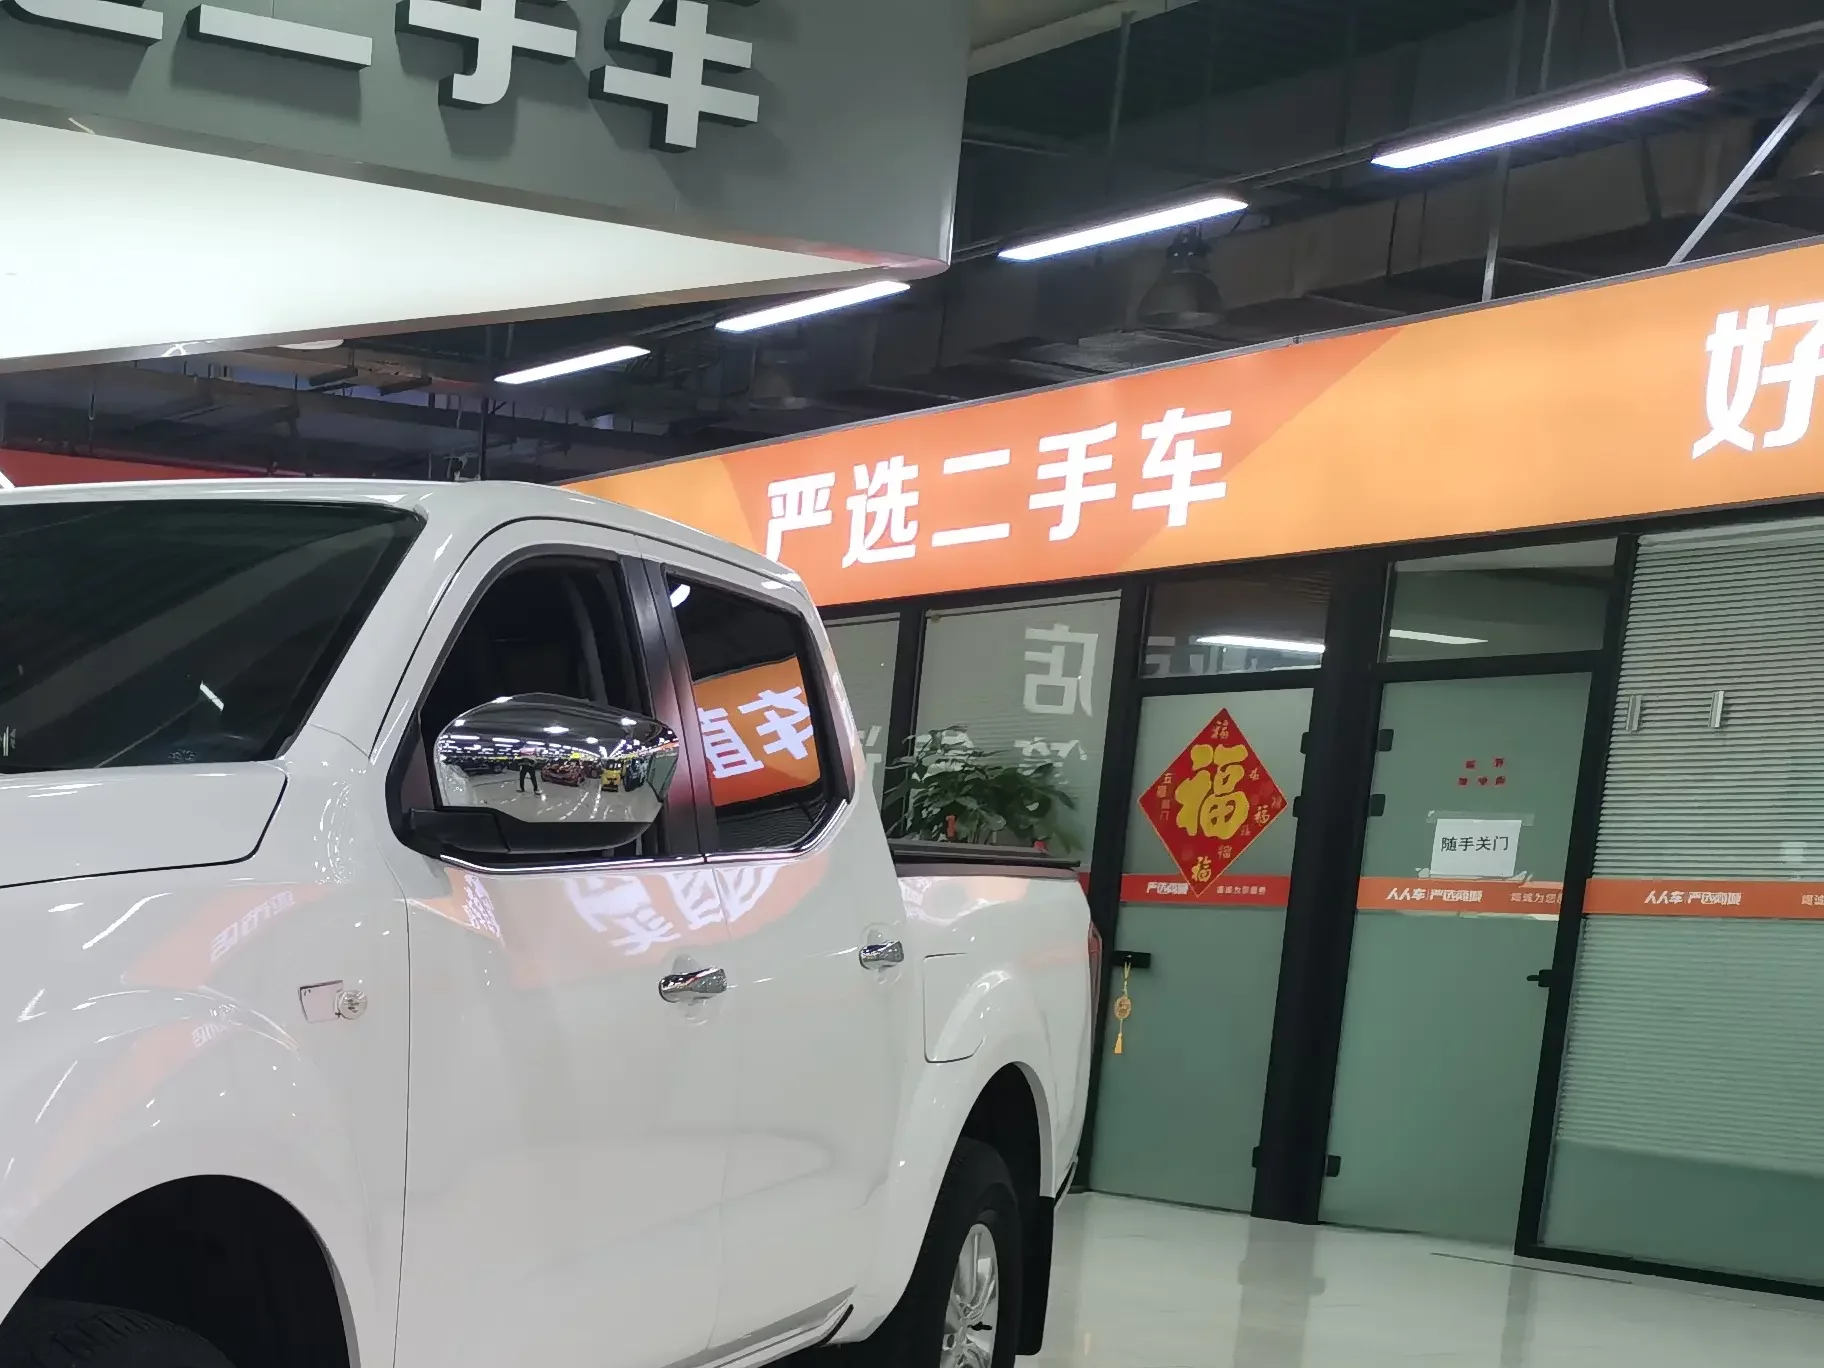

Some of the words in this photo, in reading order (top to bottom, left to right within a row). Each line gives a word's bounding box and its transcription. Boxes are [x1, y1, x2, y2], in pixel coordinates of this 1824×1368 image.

[1691, 302, 1824, 460] 好
[762, 407, 1233, 569] 严选二手车
[1175, 743, 1250, 840] 福
[1440, 835, 1509, 852] 随手关门
[1385, 887, 1426, 901] 人人车
[1644, 889, 1684, 904] 人人车
